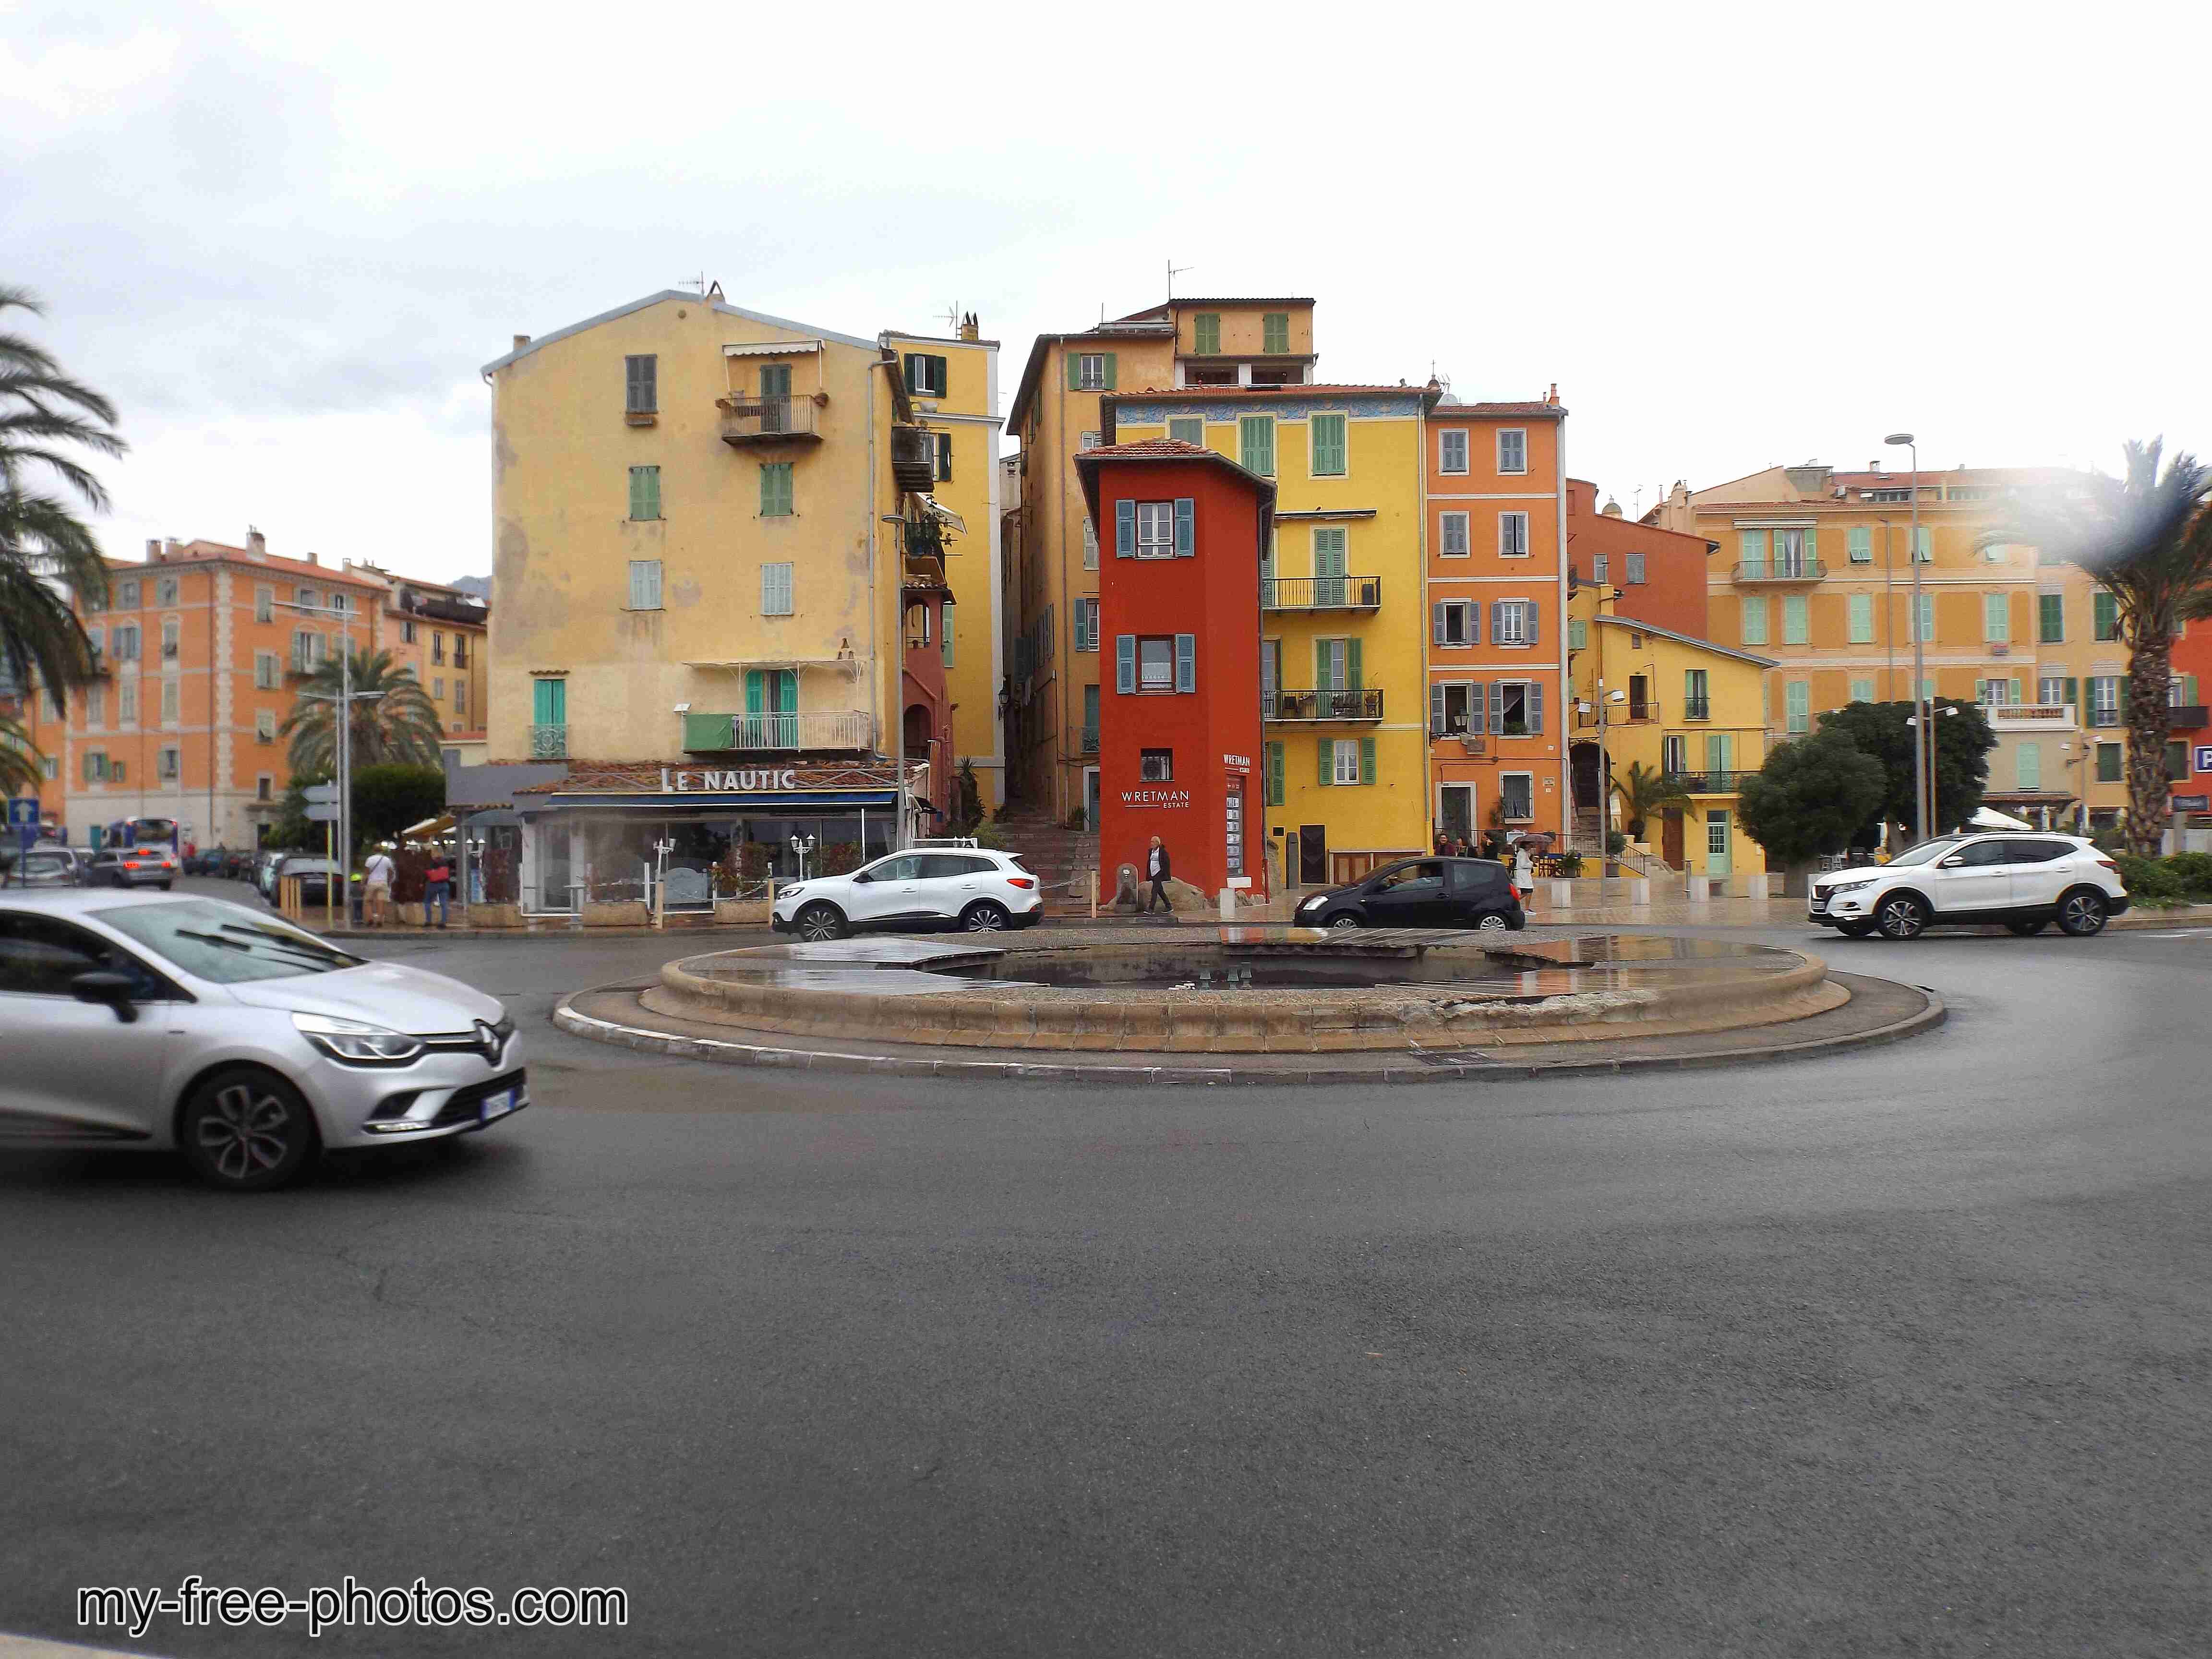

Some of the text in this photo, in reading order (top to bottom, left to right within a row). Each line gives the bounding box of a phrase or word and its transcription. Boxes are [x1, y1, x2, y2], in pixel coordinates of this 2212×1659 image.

[1223, 754, 1250, 767] WRETMAN
[2202, 750, 2212, 768] P
[661, 768, 795, 792] LE NAUTIC
[1121, 790, 1189, 802] WRETMAN
